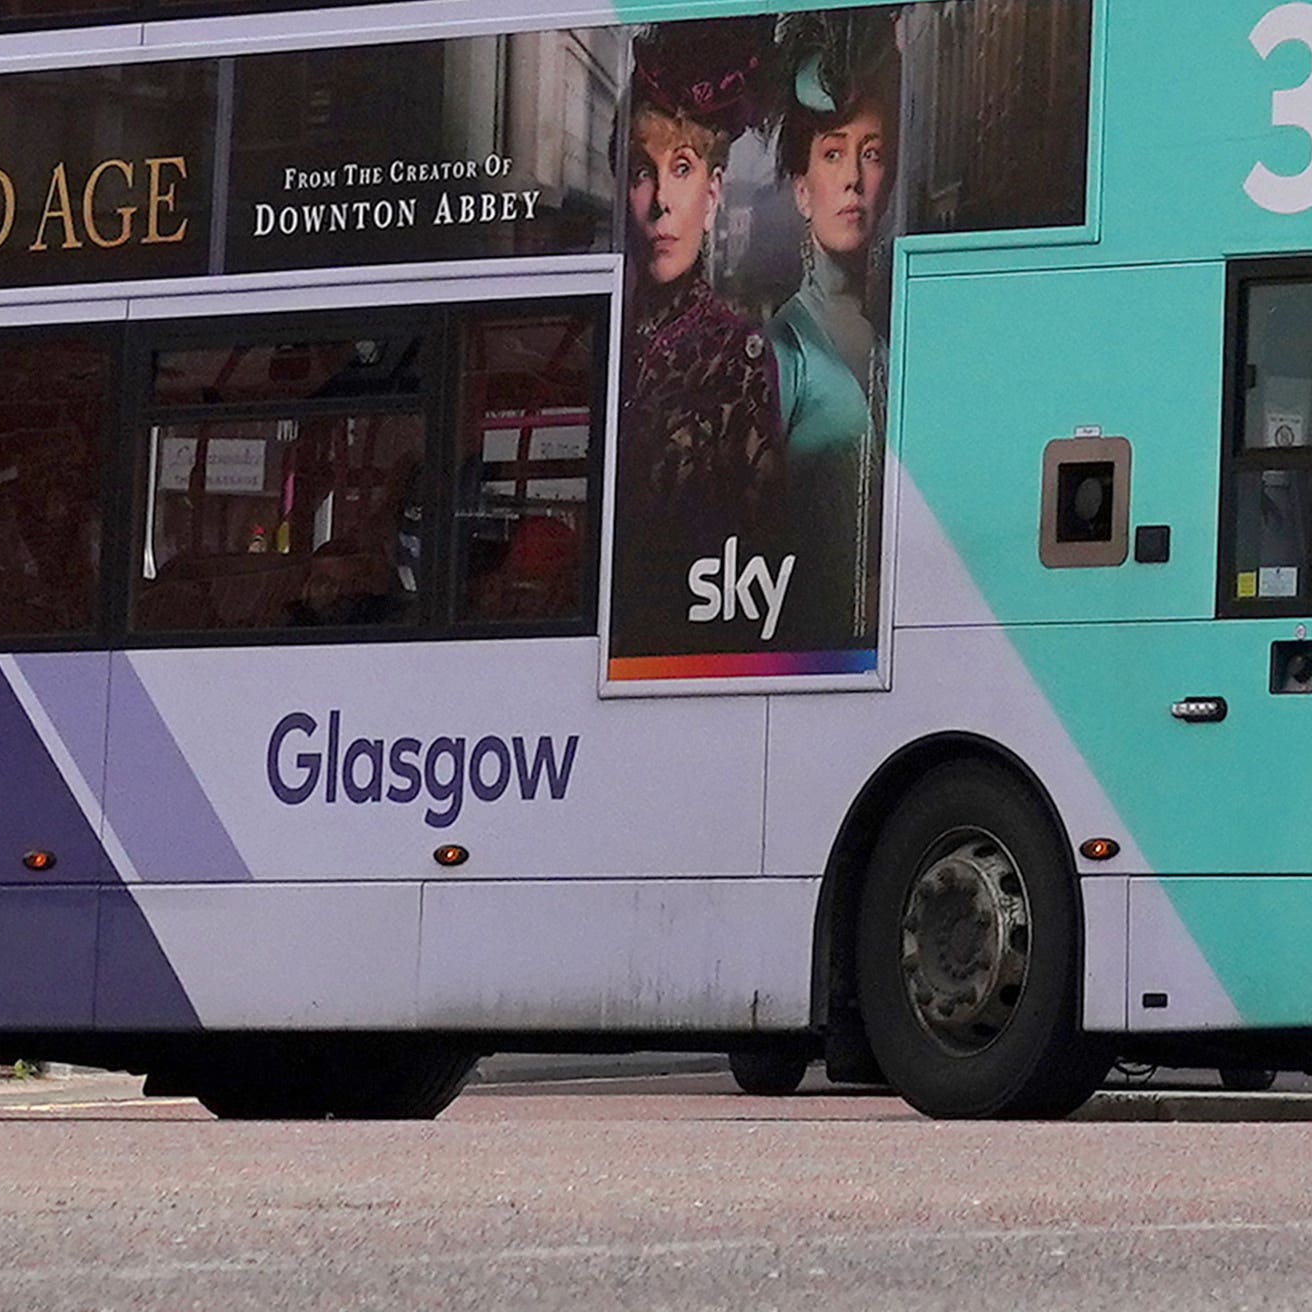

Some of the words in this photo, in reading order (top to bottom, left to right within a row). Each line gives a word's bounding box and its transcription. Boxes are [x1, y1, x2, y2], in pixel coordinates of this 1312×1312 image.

[29, 155, 189, 254] AGE
[253, 199, 419, 237] DOWNTON
[433, 190, 540, 226] ABBEY
[688, 535, 796, 640] sky
[266, 709, 580, 828] Glasgow
